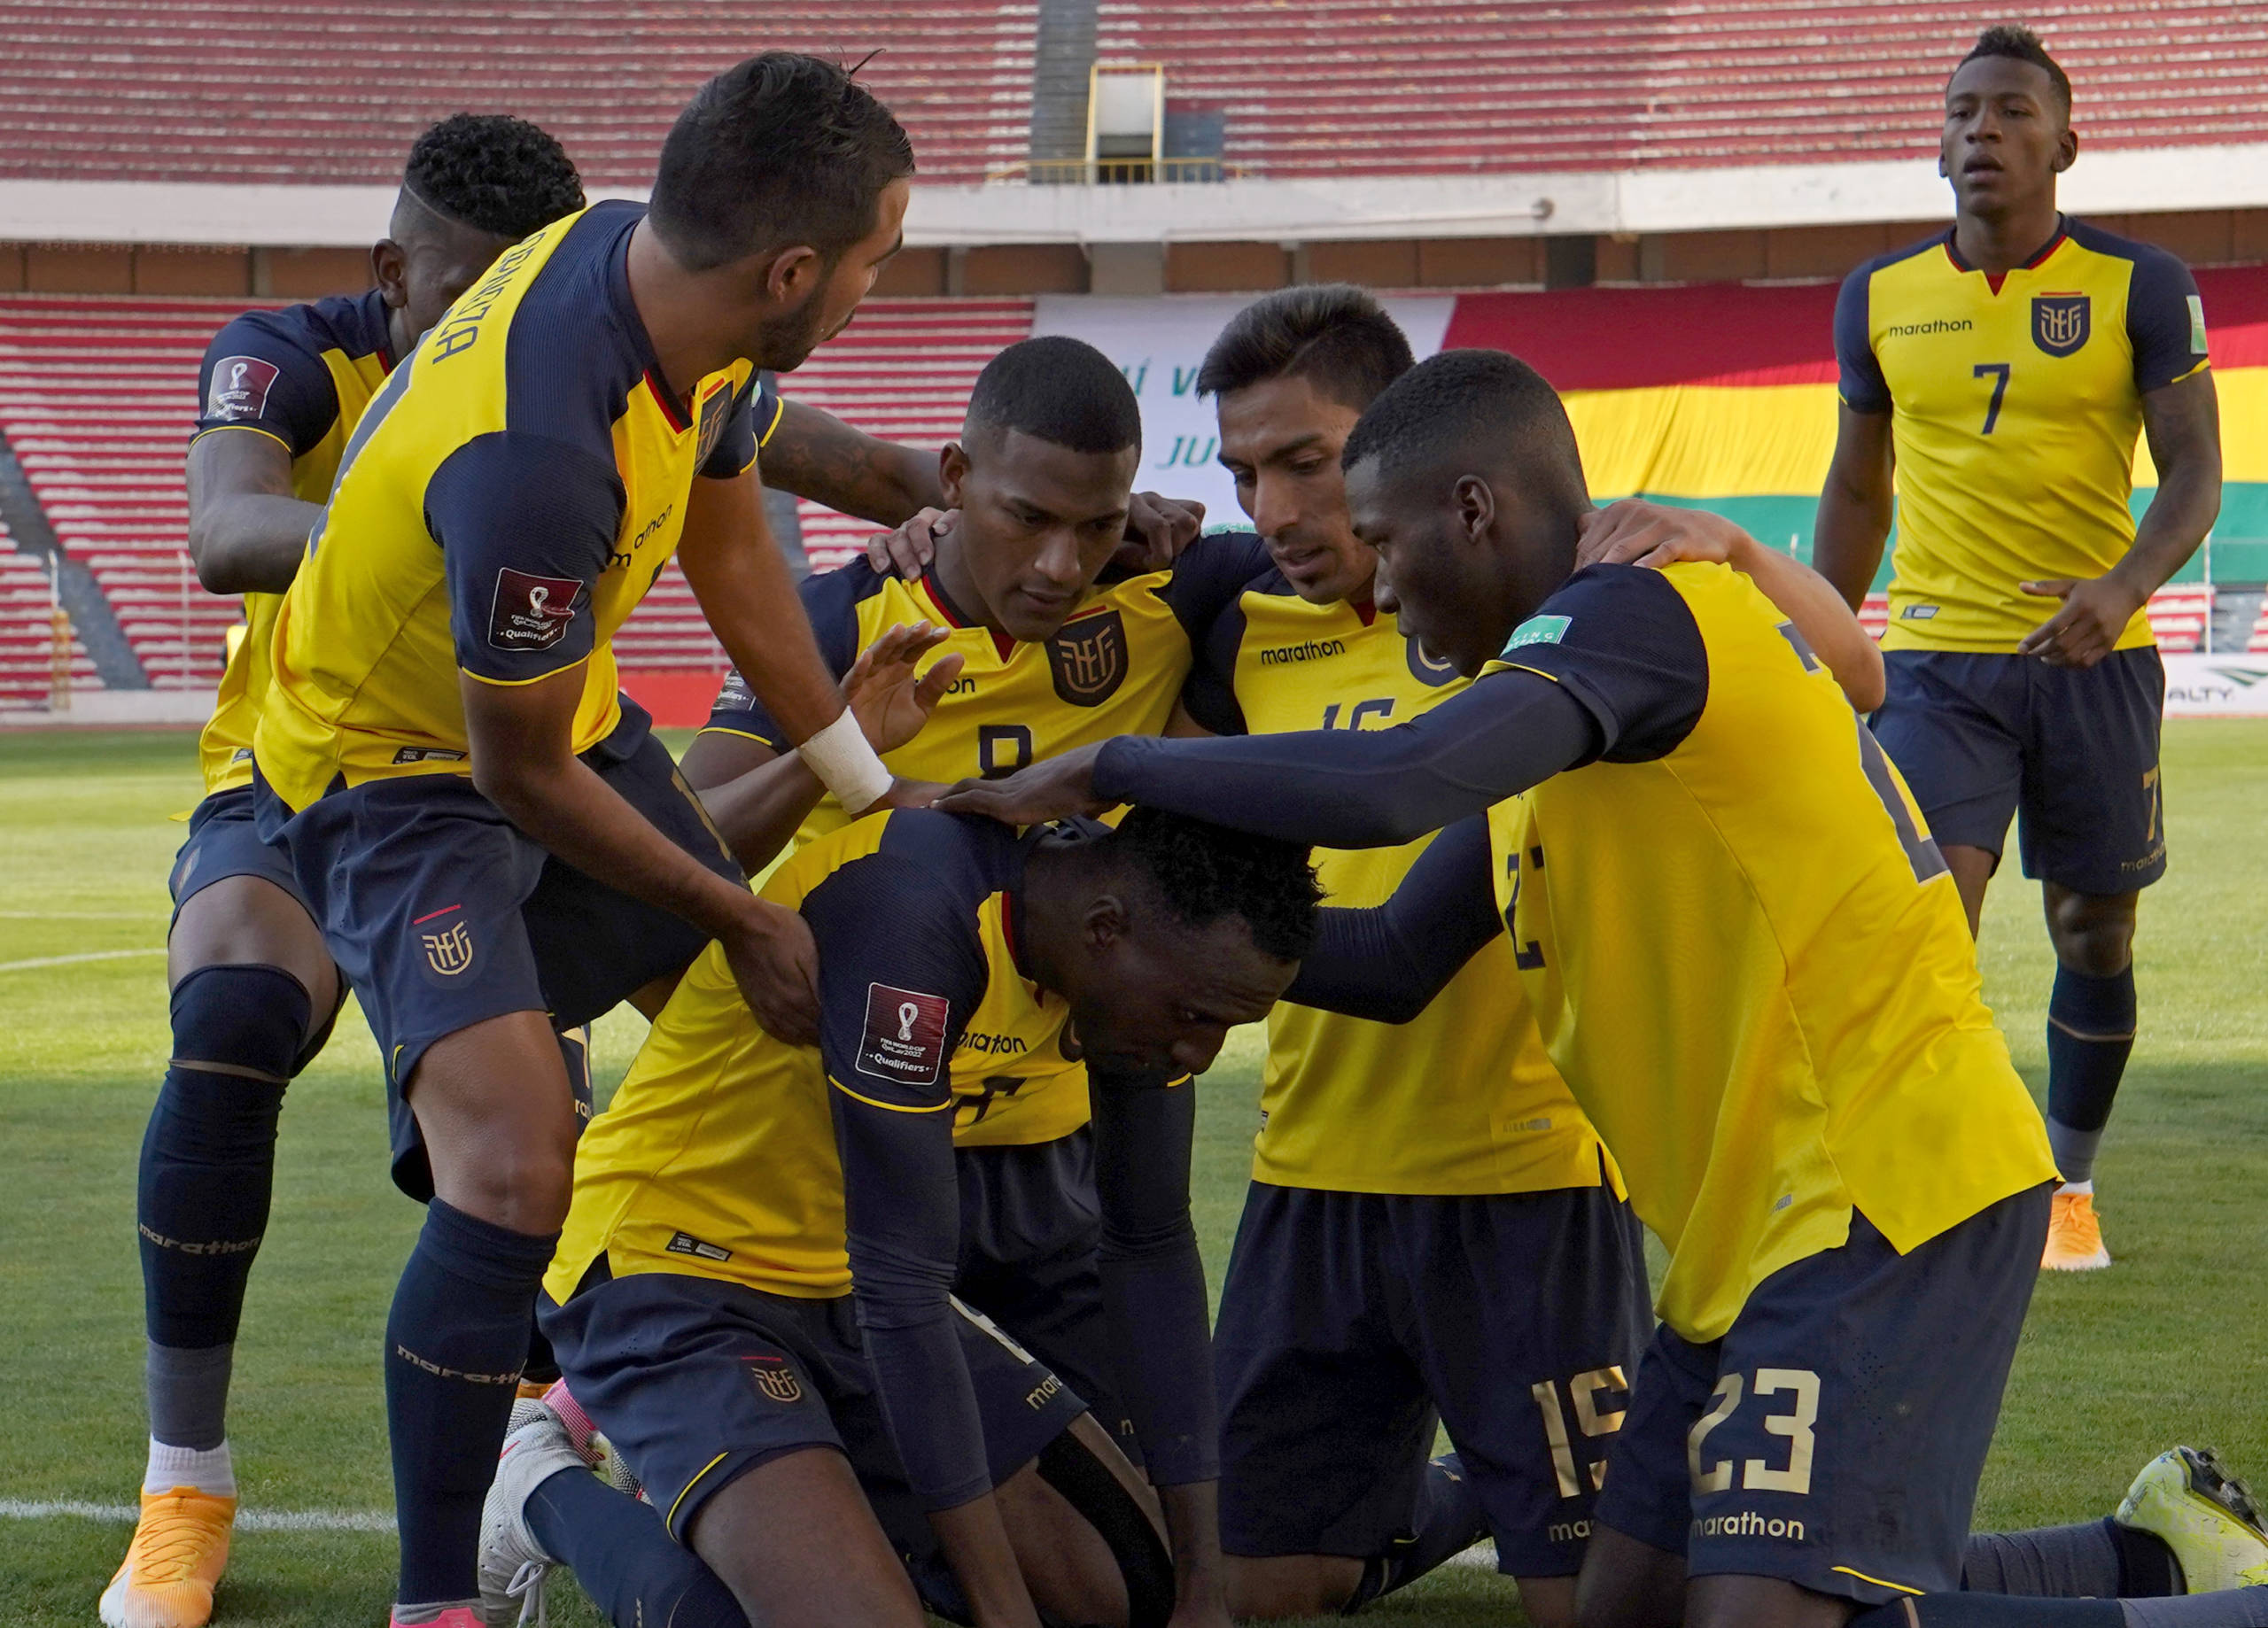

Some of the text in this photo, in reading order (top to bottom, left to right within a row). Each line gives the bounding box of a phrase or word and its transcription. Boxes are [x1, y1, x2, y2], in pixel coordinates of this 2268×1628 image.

[1889, 319, 1973, 337] marathon
[1973, 363, 2011, 435] 7
[1261, 640, 1345, 665] marathon
[2142, 764, 2160, 842] 7
[874, 1052, 926, 1073] Qualifiers
[139, 1222, 260, 1255] marathon
[1688, 1368, 1821, 1496] 23
